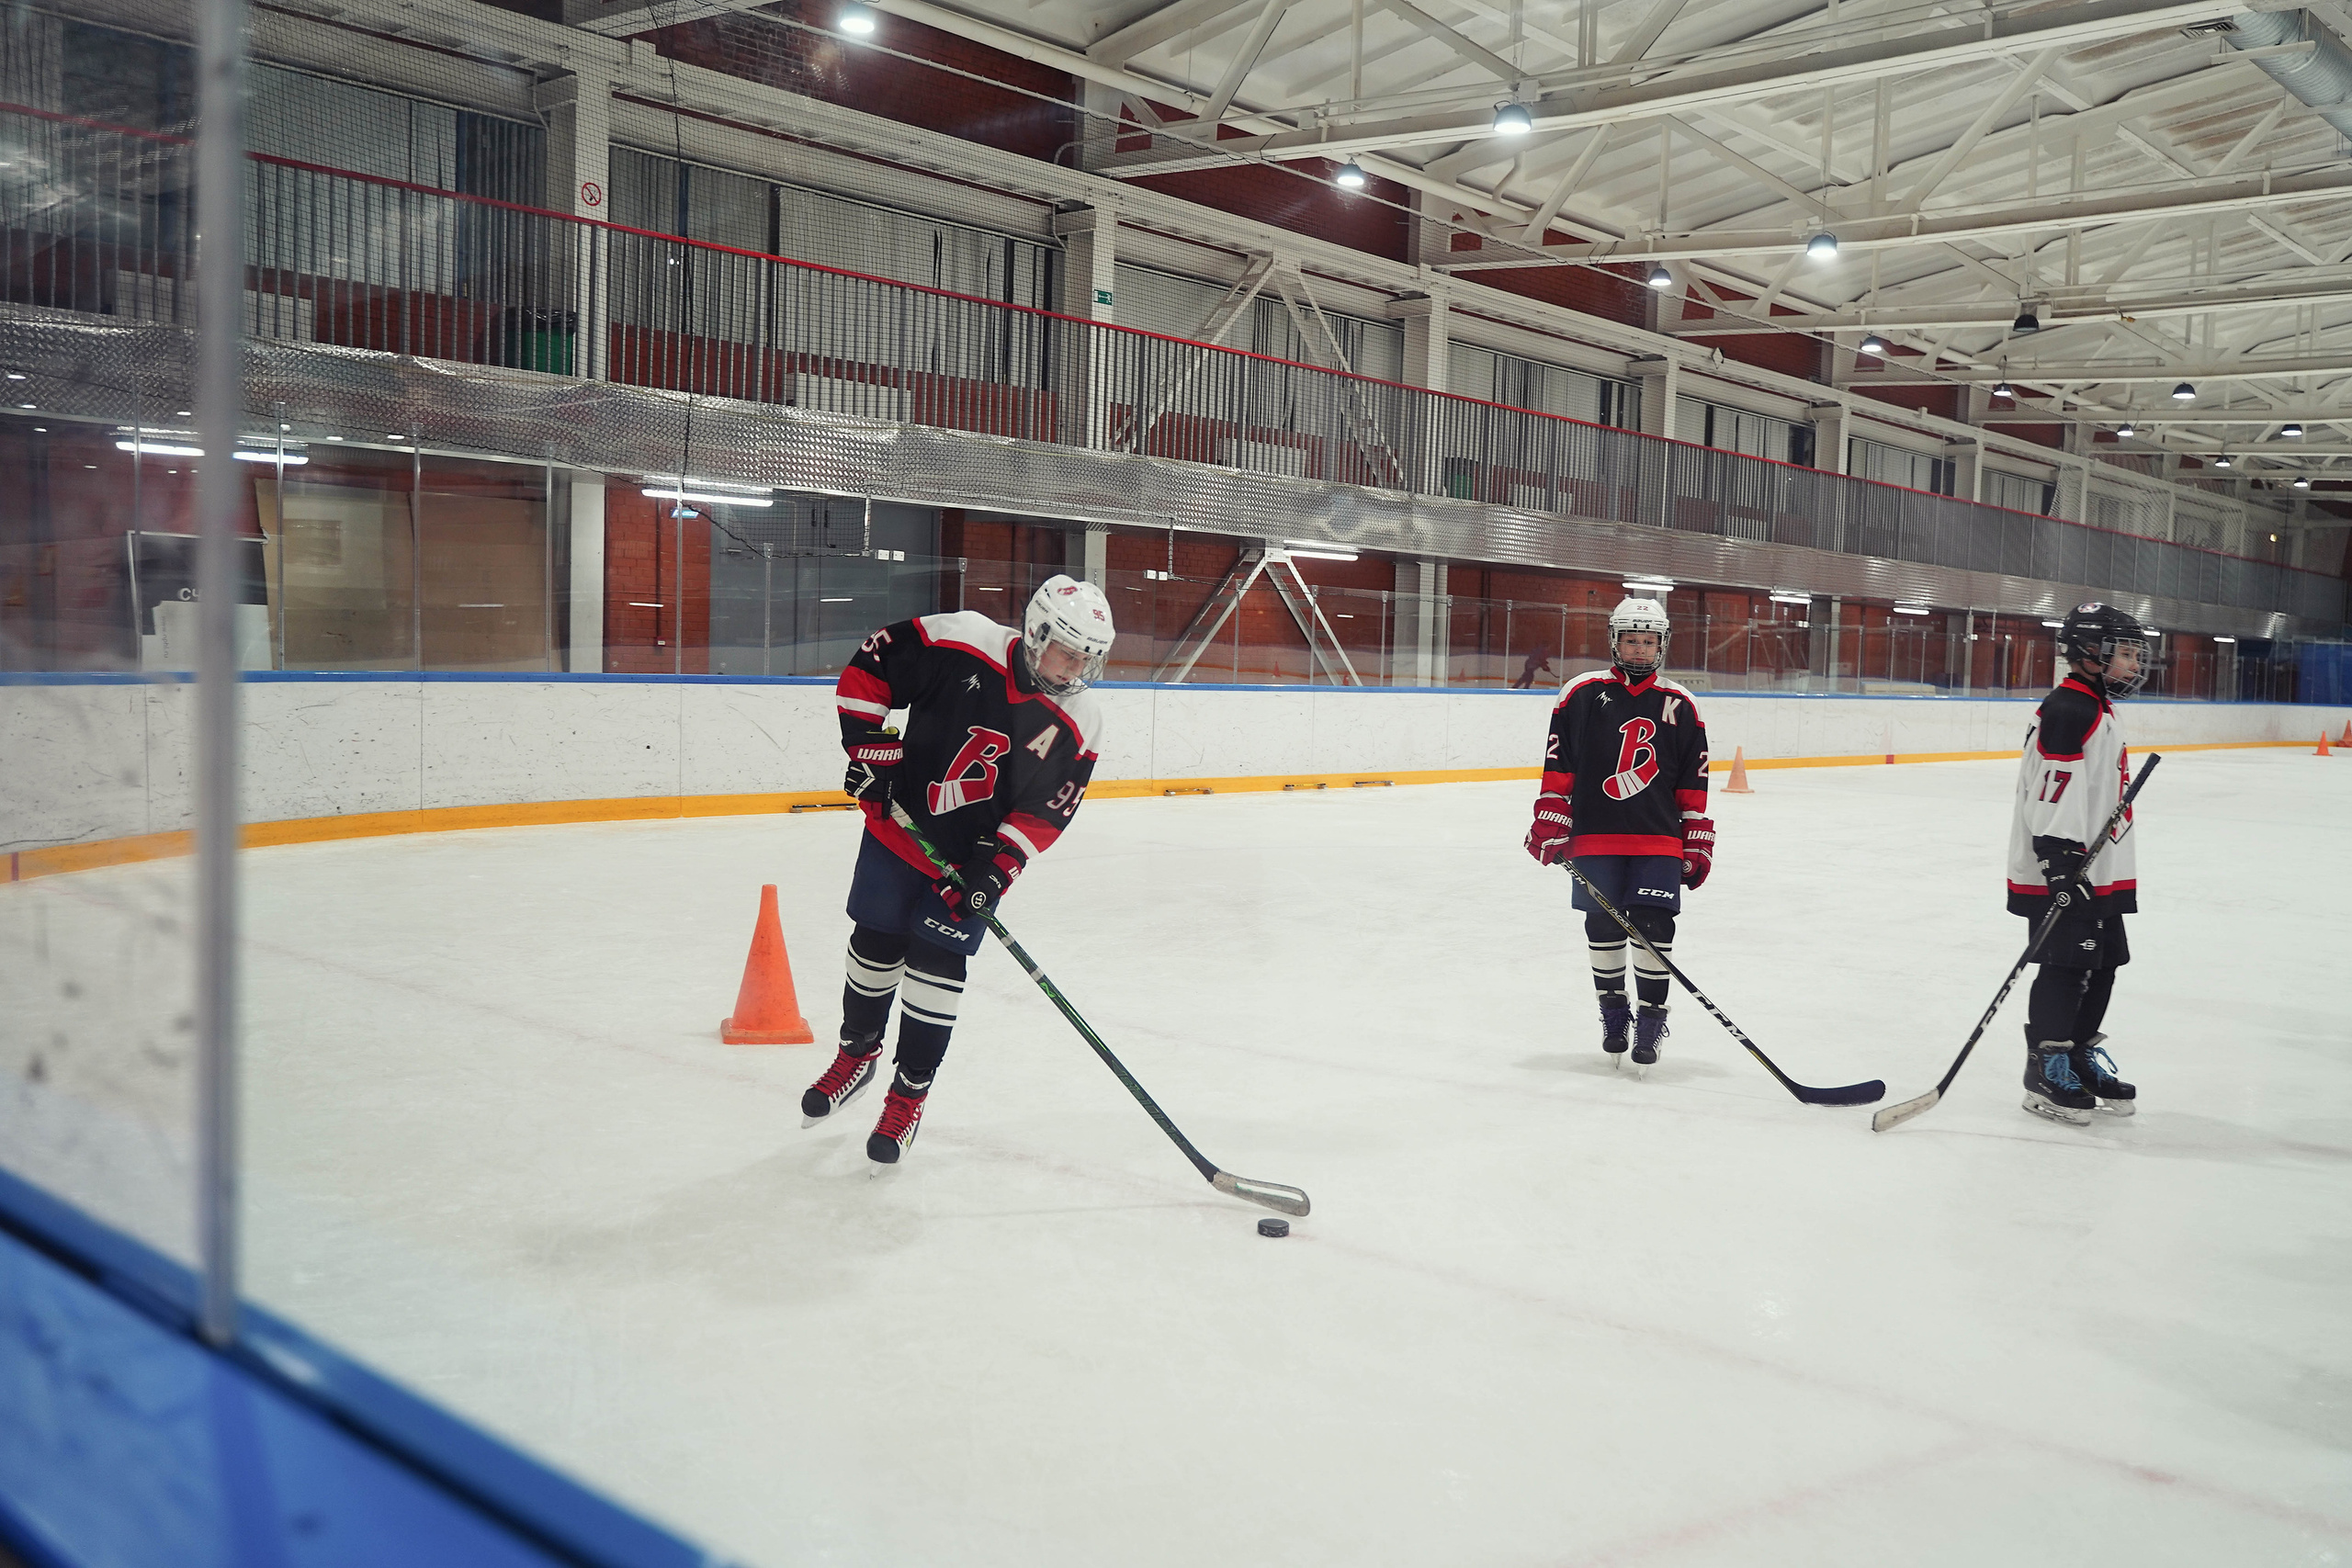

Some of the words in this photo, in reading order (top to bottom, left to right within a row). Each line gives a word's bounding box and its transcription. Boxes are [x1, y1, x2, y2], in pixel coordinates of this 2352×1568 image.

[1092, 609, 1105, 622] 95
[1661, 695, 1682, 726] K
[1024, 723, 1059, 761] A
[2039, 770, 2073, 803] 17
[1537, 809, 1574, 828] WARR
[1561, 862, 1587, 886] CCM
[1636, 887, 1676, 900] CCM
[923, 916, 970, 942] CCM
[1691, 989, 1747, 1041] CCM
